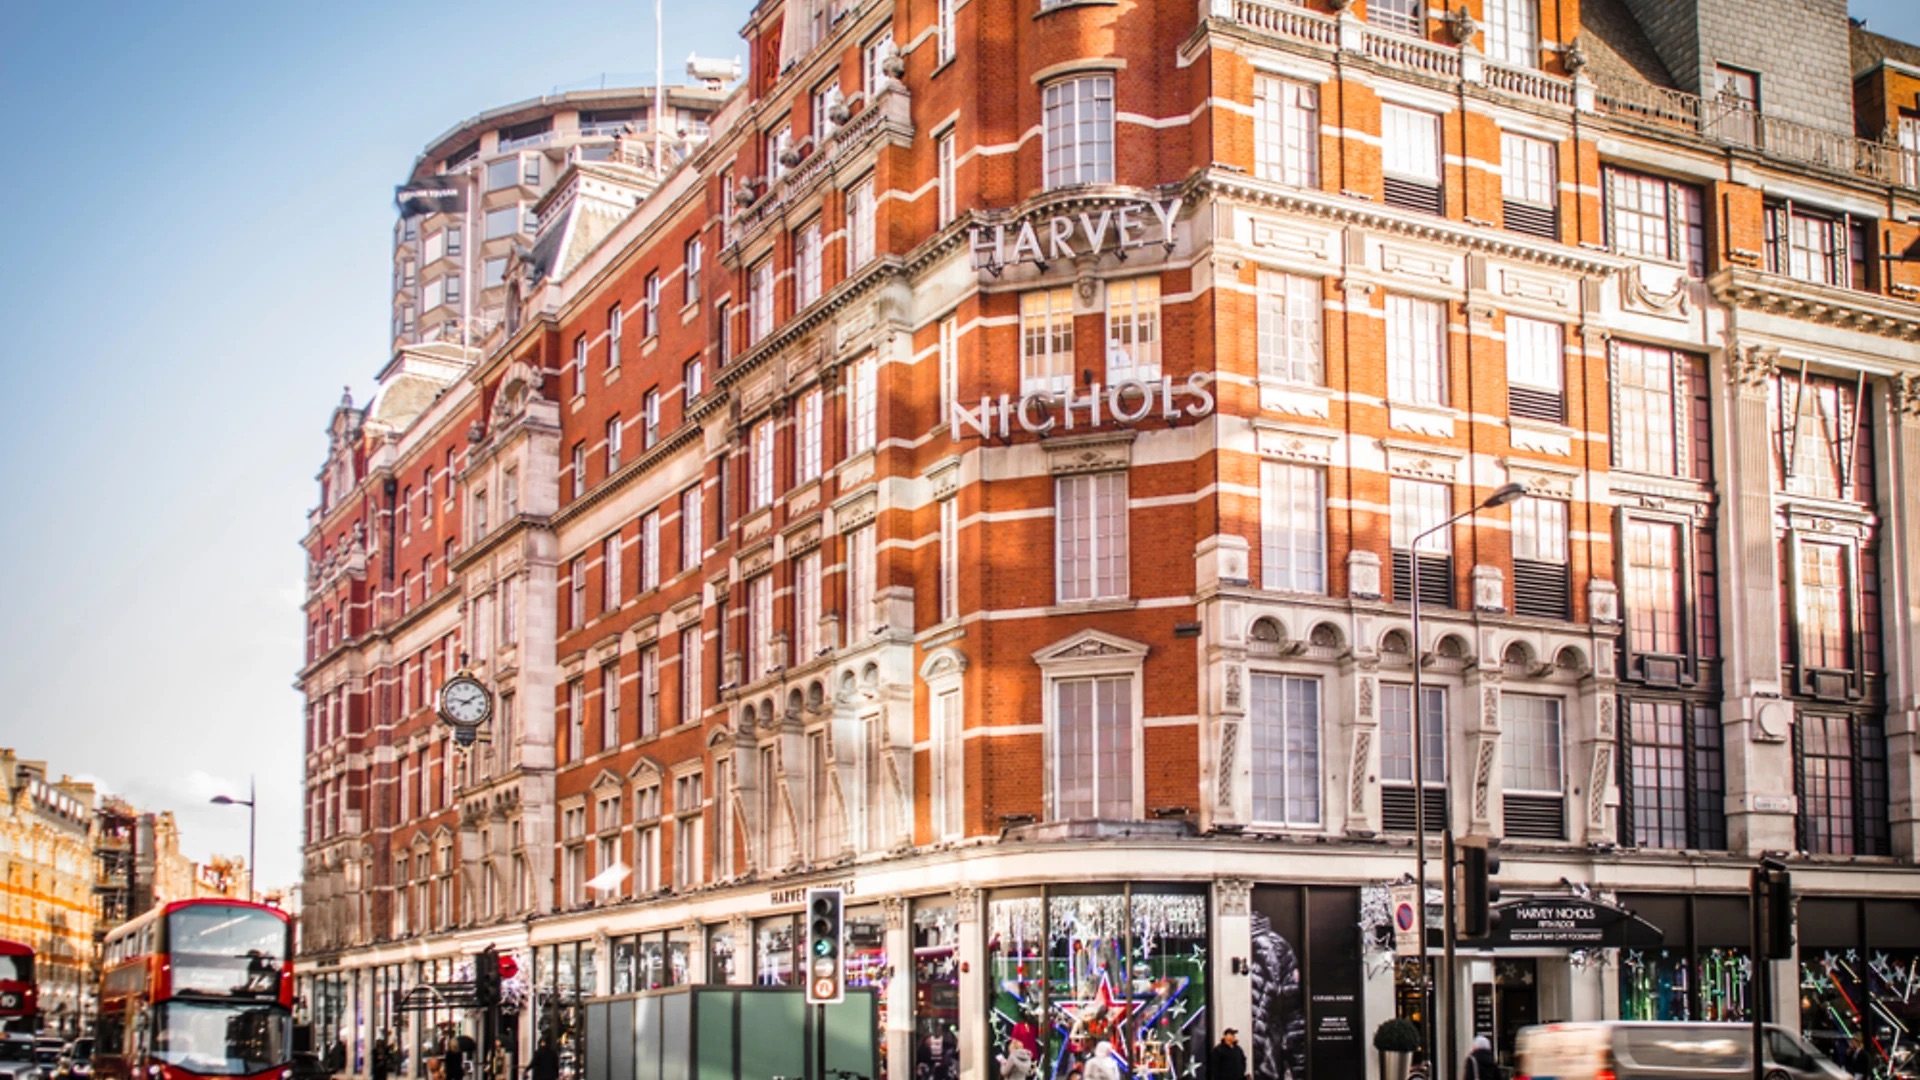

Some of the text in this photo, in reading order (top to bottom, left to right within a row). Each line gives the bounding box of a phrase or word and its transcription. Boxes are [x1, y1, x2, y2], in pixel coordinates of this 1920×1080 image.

[969, 198, 1183, 271] HARVEY
[950, 371, 1214, 443] NICHOLS
[1516, 907, 1595, 919] HARVEY NICHOLS
